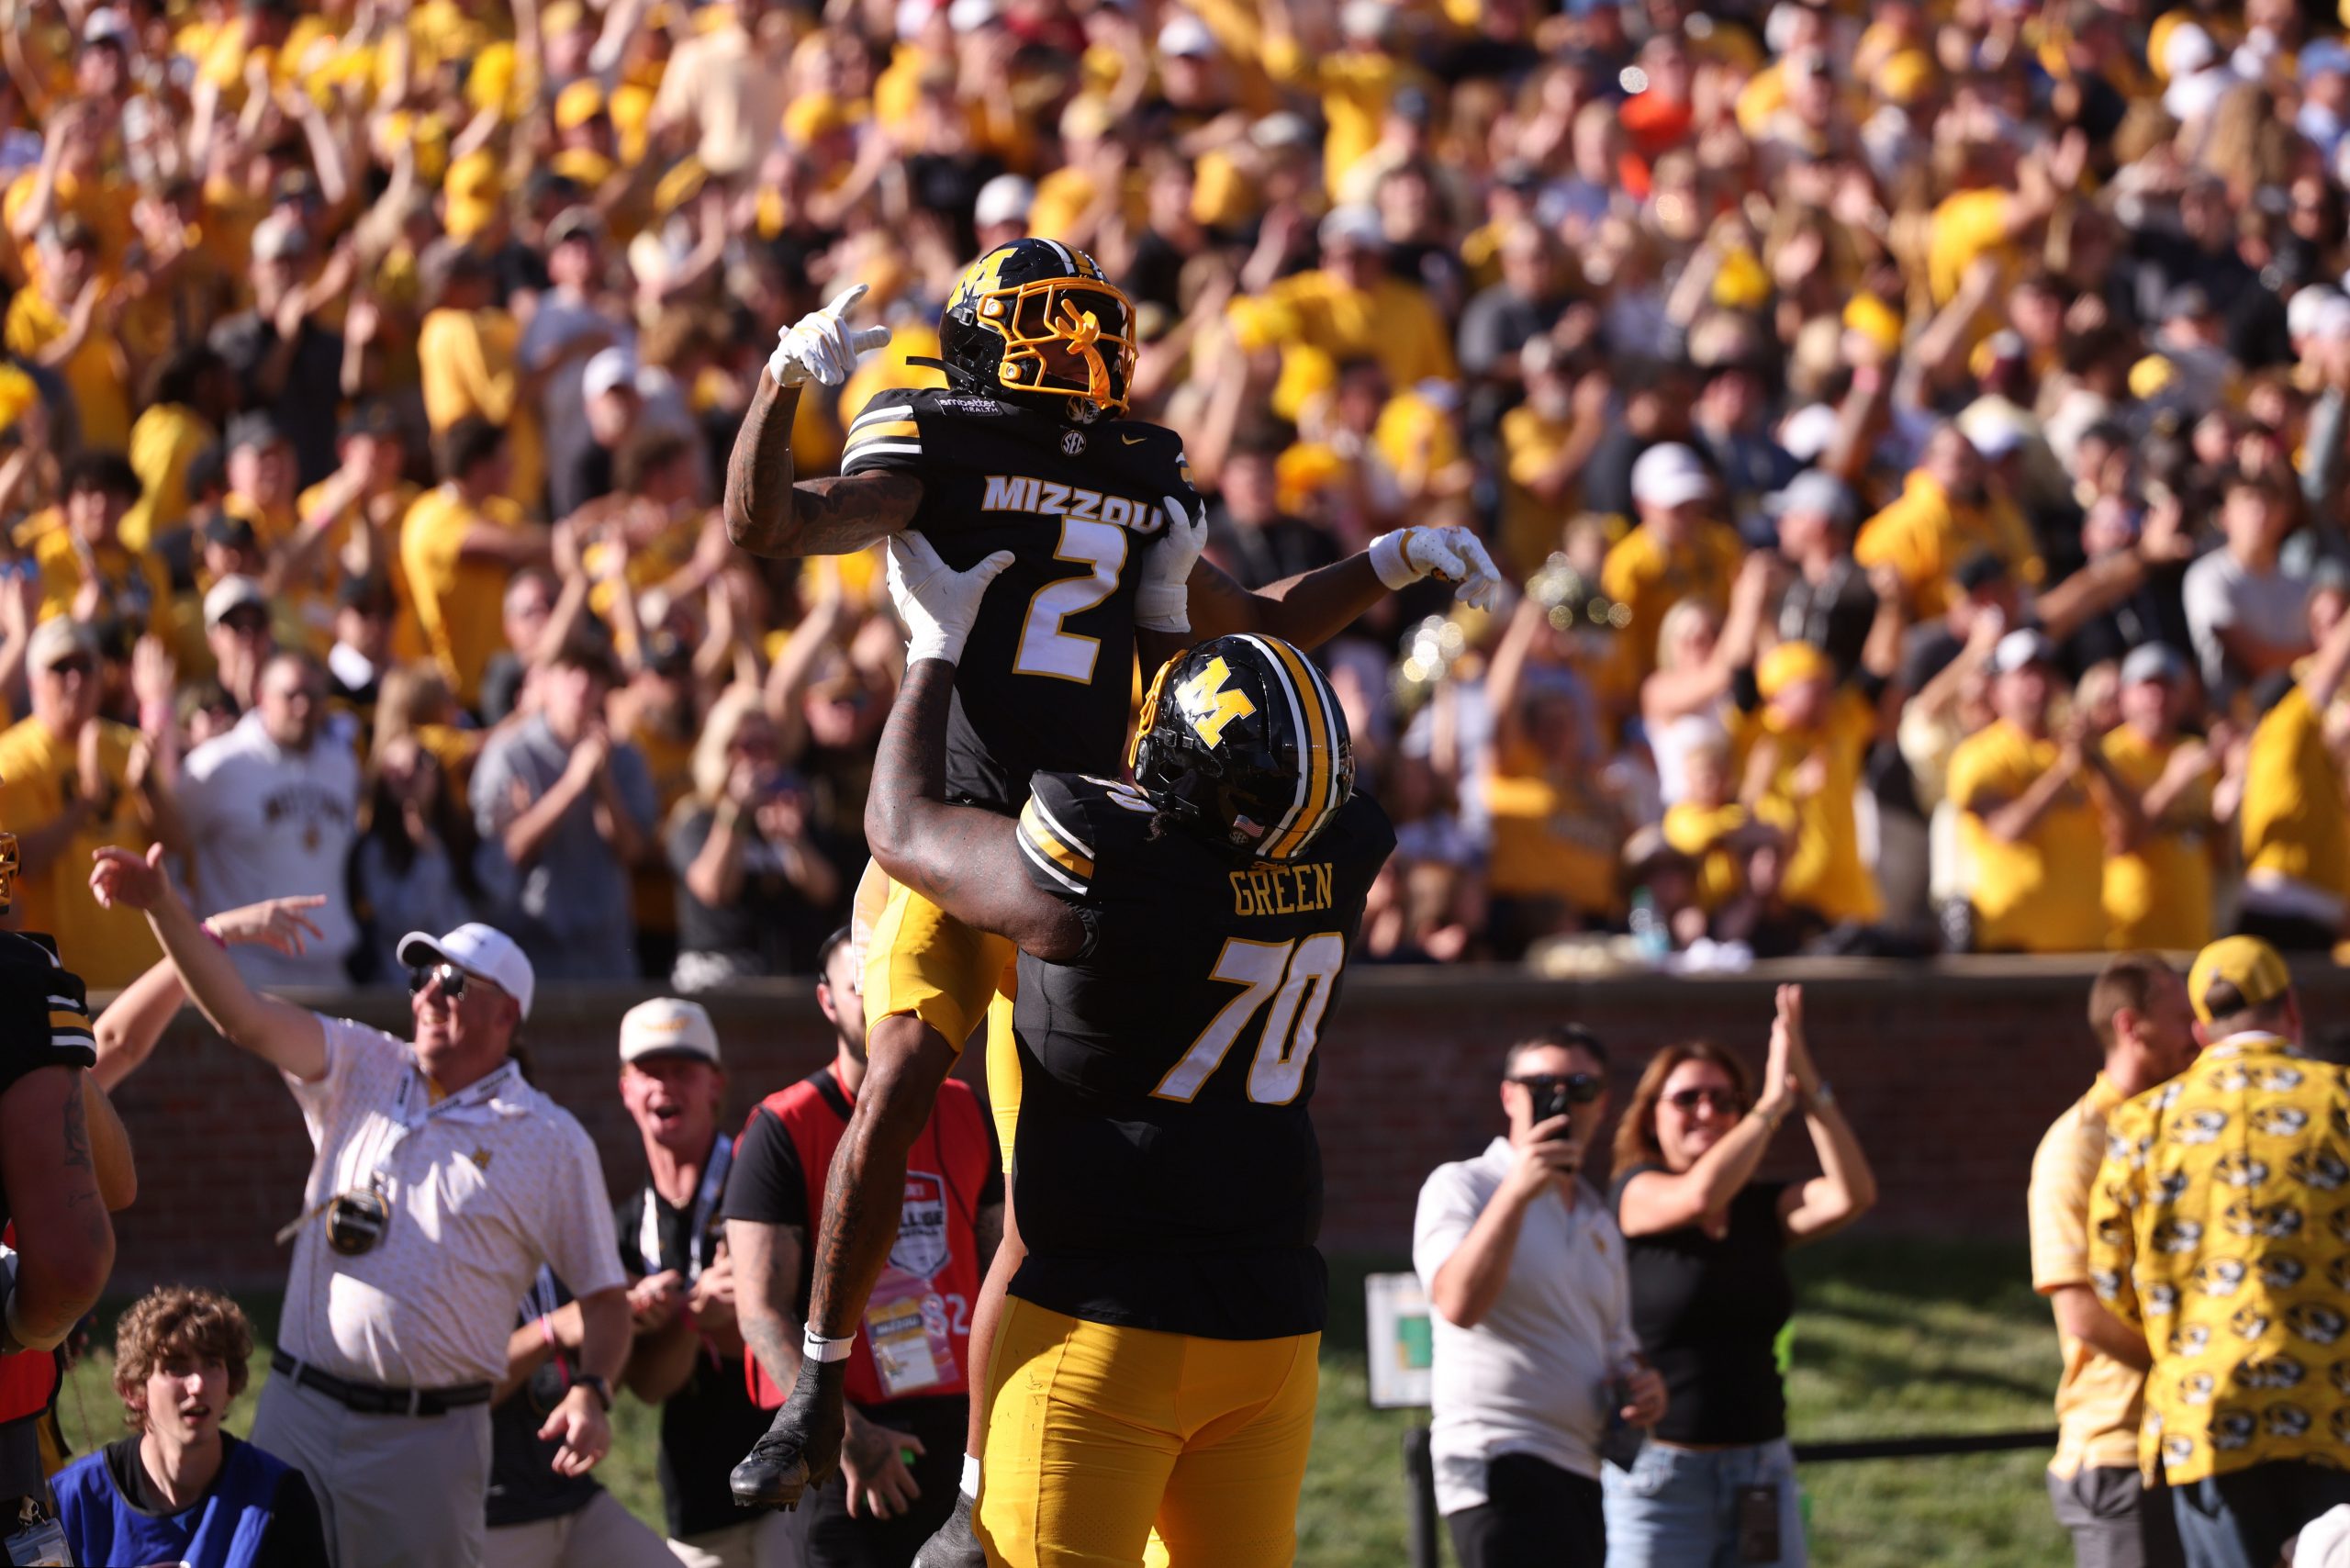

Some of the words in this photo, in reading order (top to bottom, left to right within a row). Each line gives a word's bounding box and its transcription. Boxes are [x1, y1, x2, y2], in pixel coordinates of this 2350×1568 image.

[939, 398, 996, 408] ambetter
[1063, 431, 1085, 455] SEC
[981, 475, 1165, 535] MIZZOU
[1013, 514, 1128, 686] 2
[1174, 655, 1257, 750] M
[1228, 862, 1334, 917] GREEN
[1147, 931, 1345, 1106] 70
[921, 1293, 971, 1337] 82
